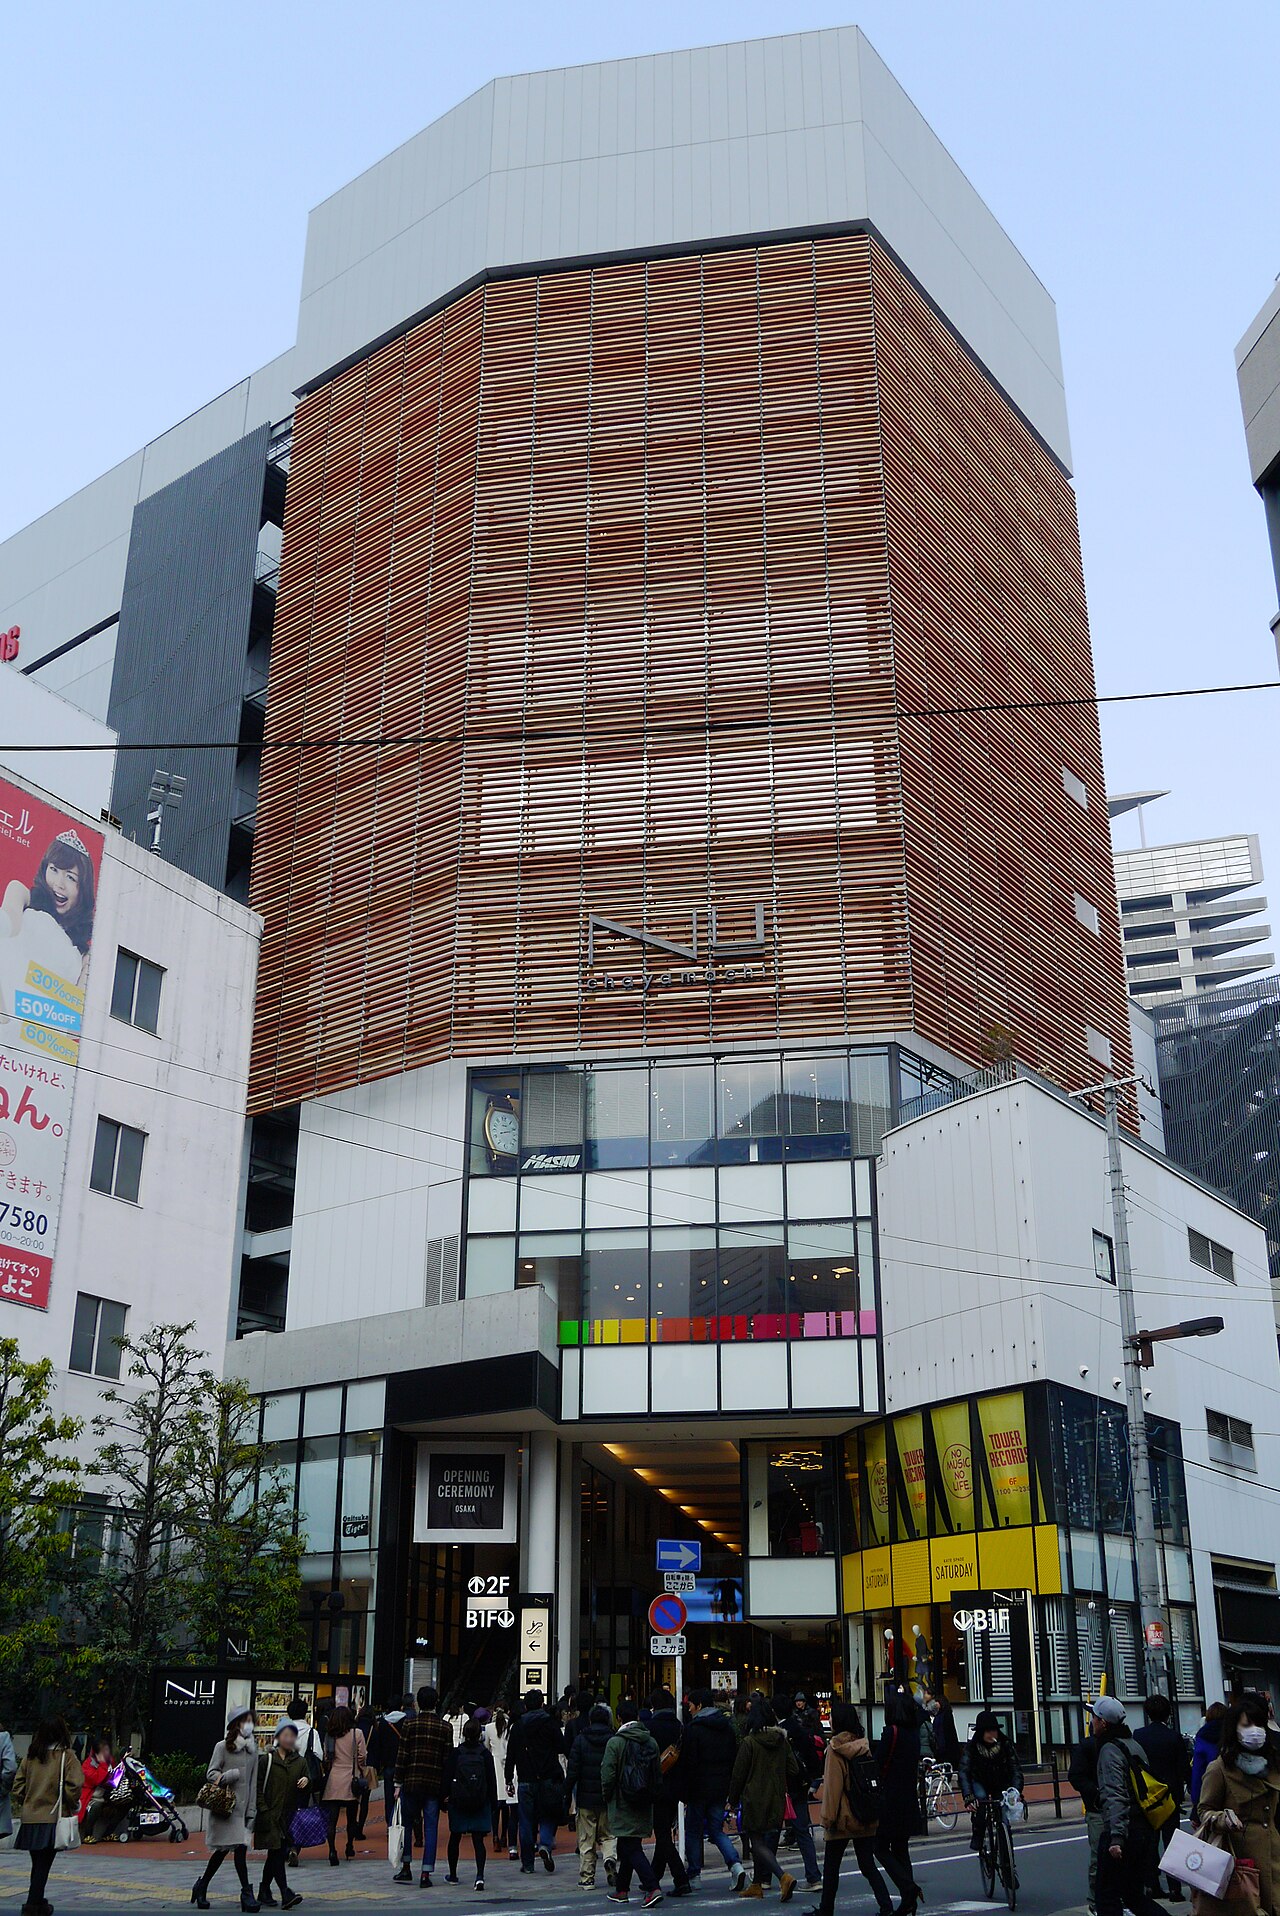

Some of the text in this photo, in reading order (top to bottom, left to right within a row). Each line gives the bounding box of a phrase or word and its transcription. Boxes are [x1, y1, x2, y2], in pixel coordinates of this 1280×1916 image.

[586, 963, 767, 990] chayamachi
[32, 969, 81, 1007] 30%OFF
[21, 997, 76, 1025] 50%OFF
[26, 1025, 76, 1059] 60%OFF
[0, 1085, 63, 1137] ん。
[0, 1201, 48, 1236] 7580
[989, 1430, 1022, 1450] TOWER
[951, 1449, 962, 1458] NO
[946, 1457, 971, 1470] MUSIC
[443, 1470, 490, 1483] OPENING
[954, 1470, 965, 1480] NO
[1008, 1477, 1017, 1486] 6F
[437, 1485, 495, 1498] CEREMONY
[454, 1504, 476, 1513] OSAKA
[935, 1563, 974, 1581] SATURDAY
[486, 1576, 510, 1595] 2F
[665, 1581, 694, 1591] ここから
[466, 1610, 498, 1628] B1F
[974, 1609, 1009, 1633] B1F
[652, 1645, 686, 1655] ここから
[165, 1680, 216, 1699] NU
